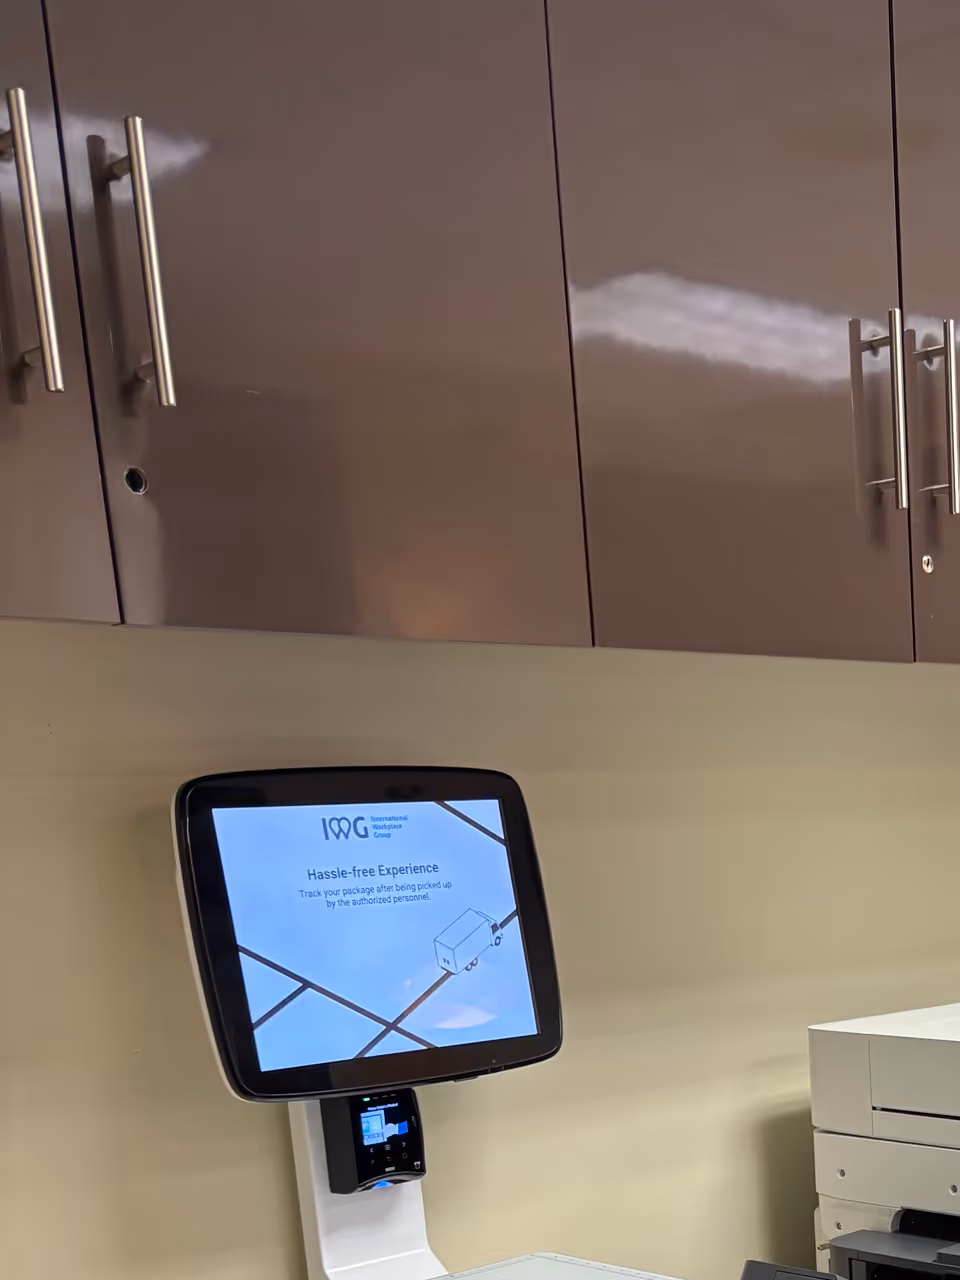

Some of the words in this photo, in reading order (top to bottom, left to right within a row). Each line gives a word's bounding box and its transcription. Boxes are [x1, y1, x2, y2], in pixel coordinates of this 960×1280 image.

[370, 814, 409, 822] International
[372, 823, 403, 831] Workplace
[321, 816, 369, 840] IWG
[307, 865, 376, 881] Hassle-free
[378, 862, 439, 878] Experience
[298, 887, 323, 898] Track
[323, 889, 341, 902] your
[342, 886, 375, 898] package
[376, 884, 394, 893] after
[395, 882, 417, 894] being
[417, 880, 441, 893] picked
[442, 881, 452, 891] up
[326, 900, 336, 910] by
[337, 898, 350, 907] the
[351, 895, 392, 906] authorized
[393, 892, 431, 904] personnel.
